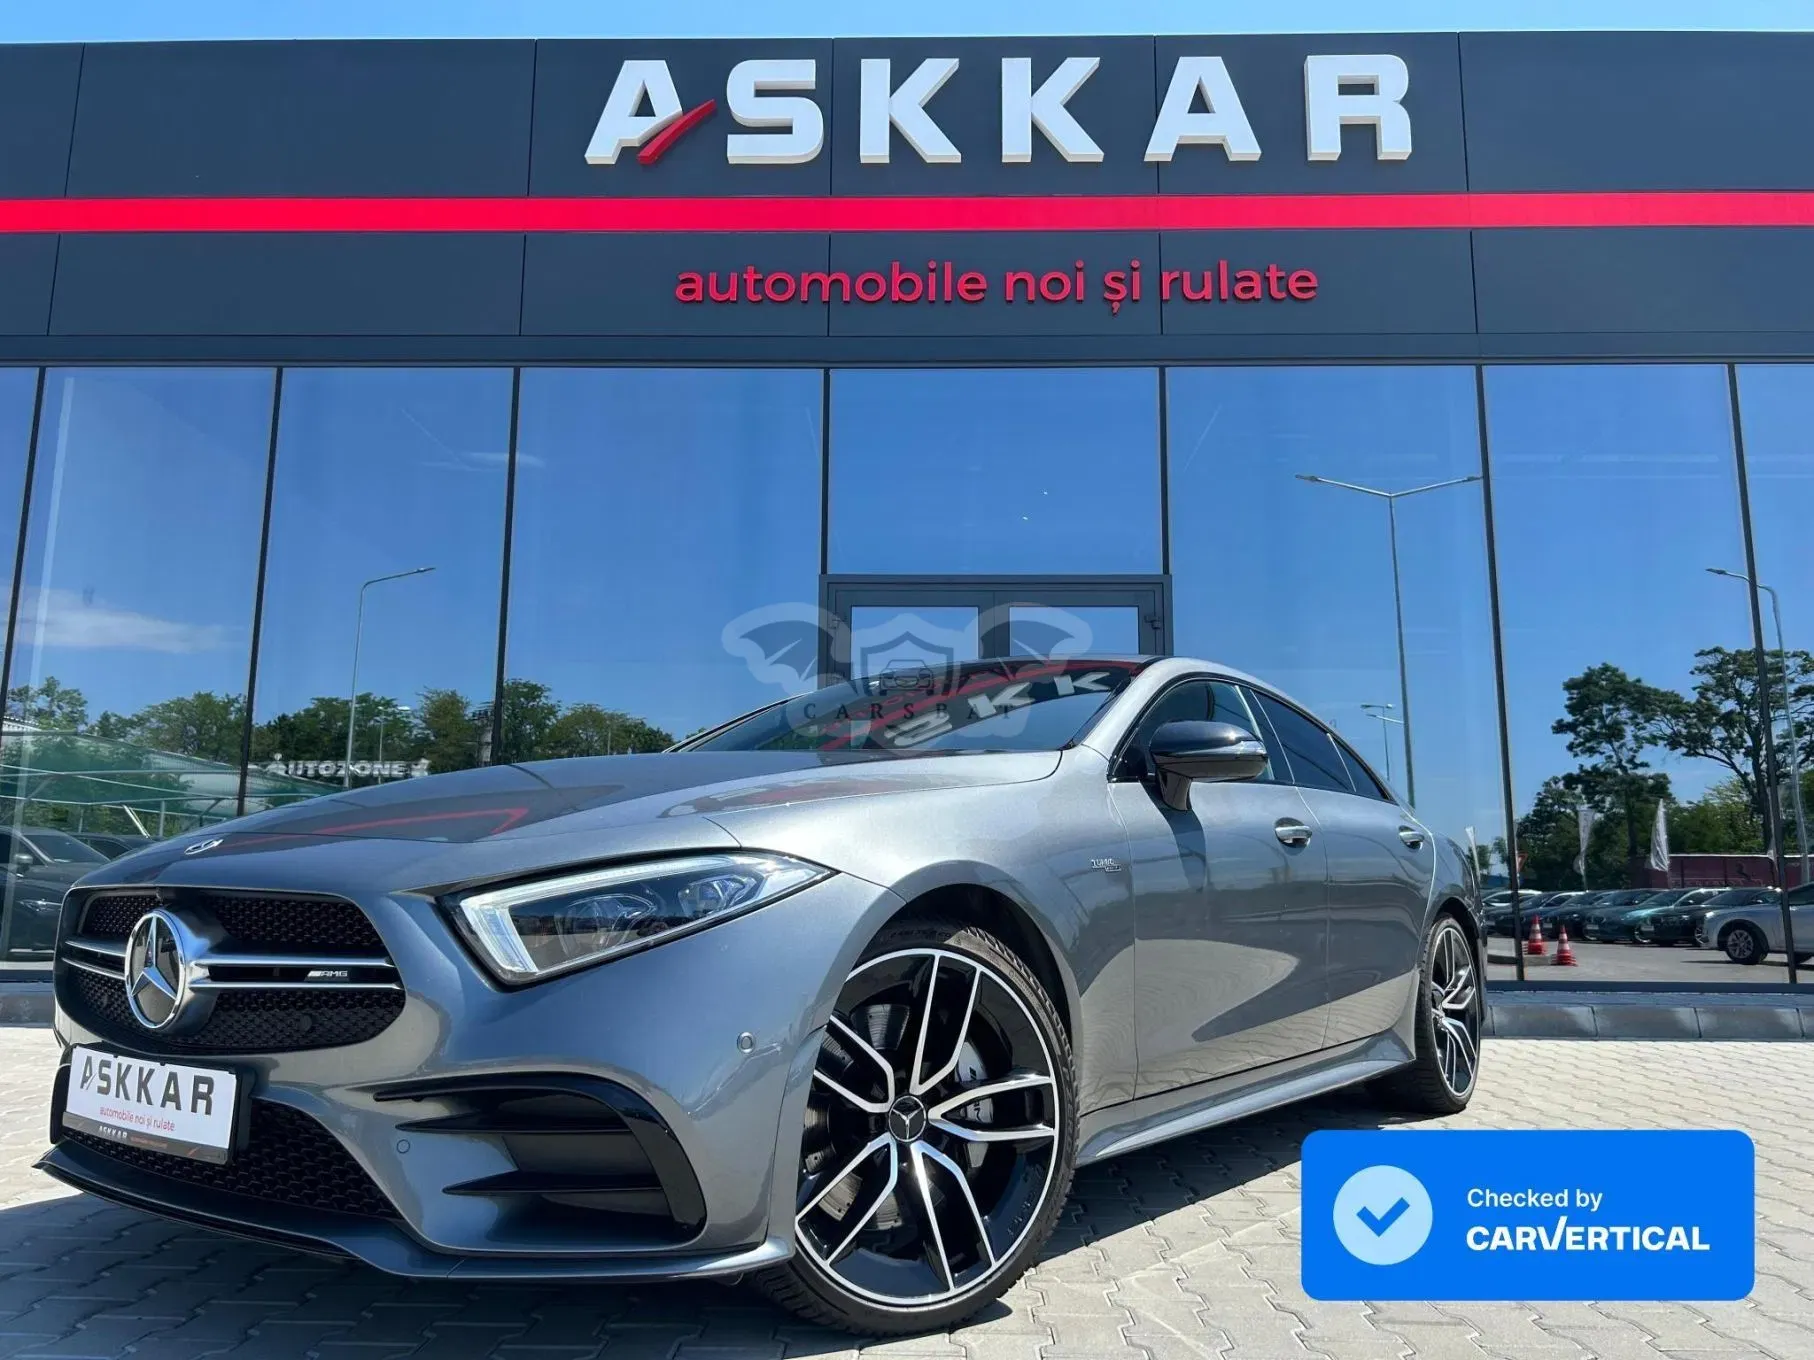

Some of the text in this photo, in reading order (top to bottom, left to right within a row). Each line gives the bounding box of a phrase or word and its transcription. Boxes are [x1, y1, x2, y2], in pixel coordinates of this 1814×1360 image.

[585, 54, 1412, 165] ASKKAR
[674, 260, 1320, 315] automobile noi și rulate
[79, 1055, 215, 1116] ASKKAR
